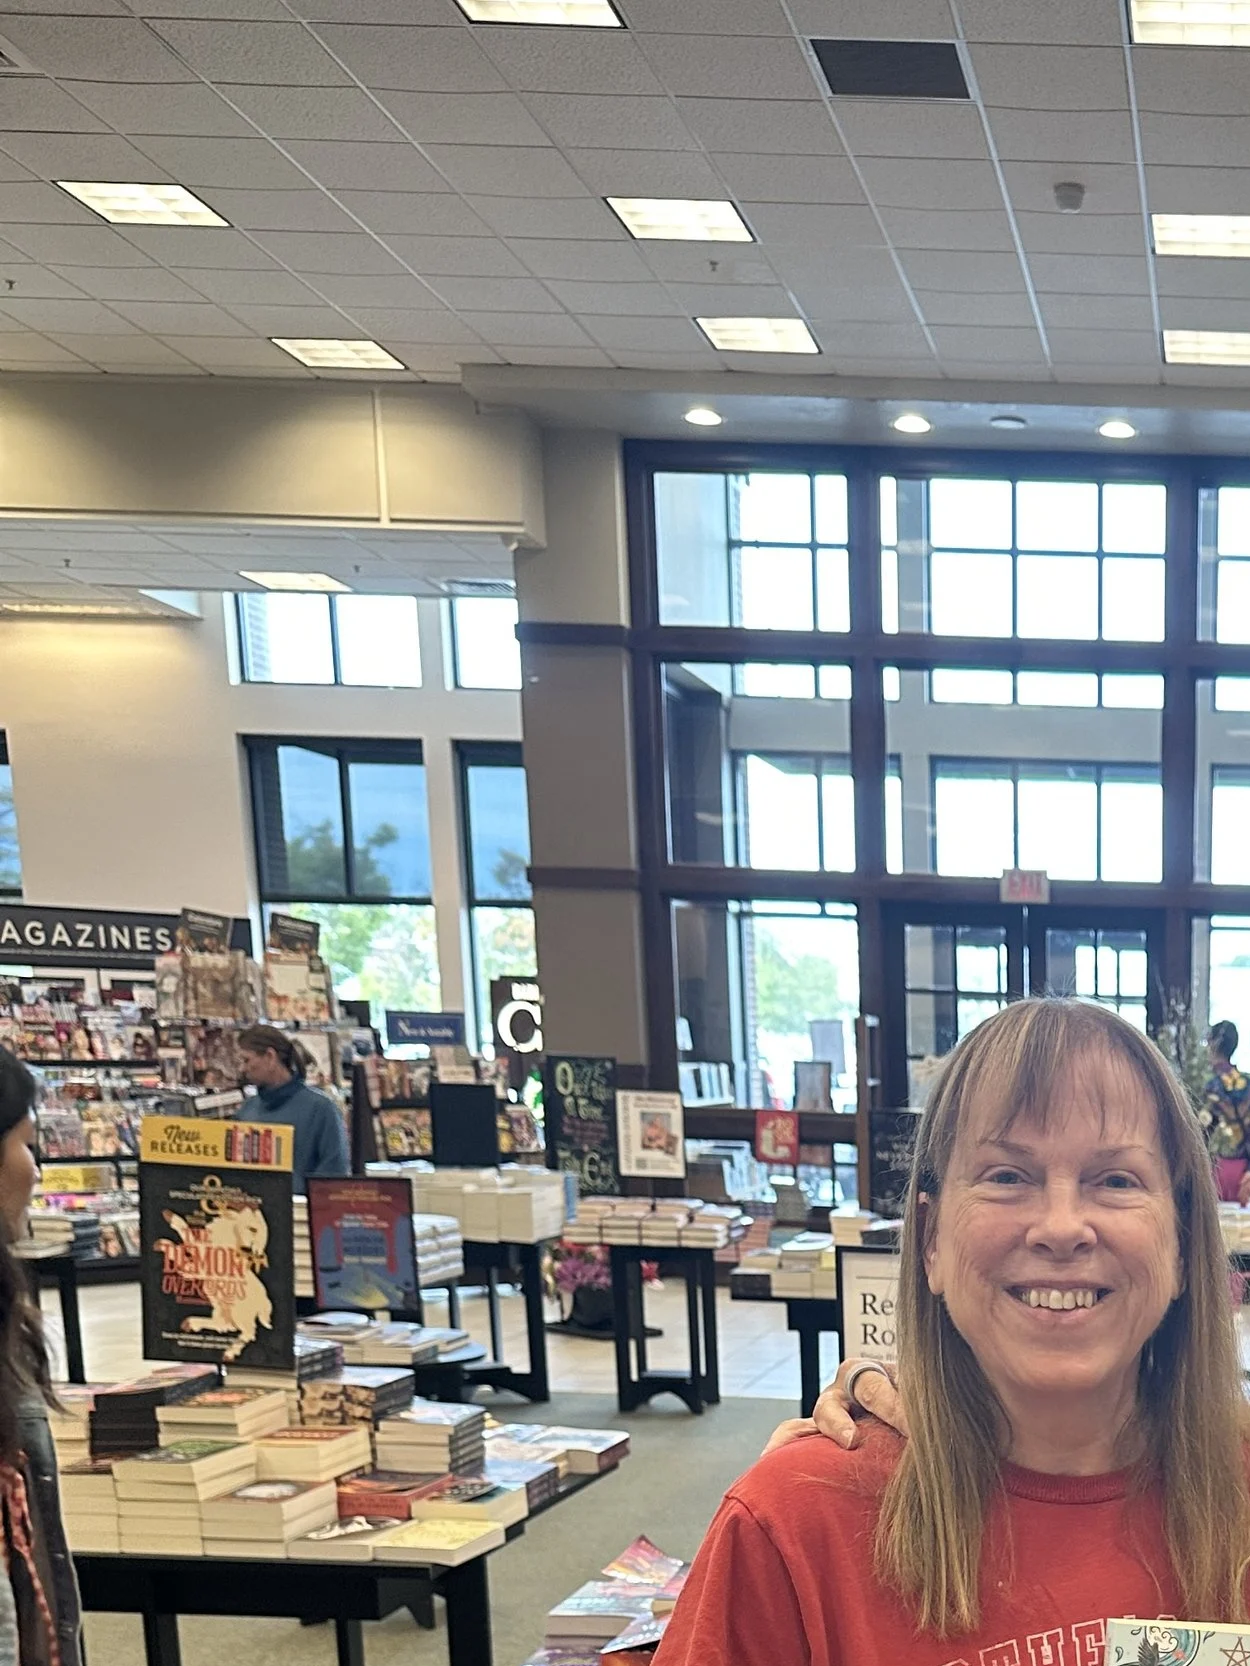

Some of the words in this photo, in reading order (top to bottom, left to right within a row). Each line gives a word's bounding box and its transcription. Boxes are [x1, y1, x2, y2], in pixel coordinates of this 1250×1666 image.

[0, 920, 173, 951] AGAZINES
[163, 1124, 201, 1143] New
[149, 1139, 219, 1157] RELEASES
[162, 1243, 246, 1278] DEMON
[860, 1292, 894, 1316] Re
[860, 1323, 896, 1346] Ro
